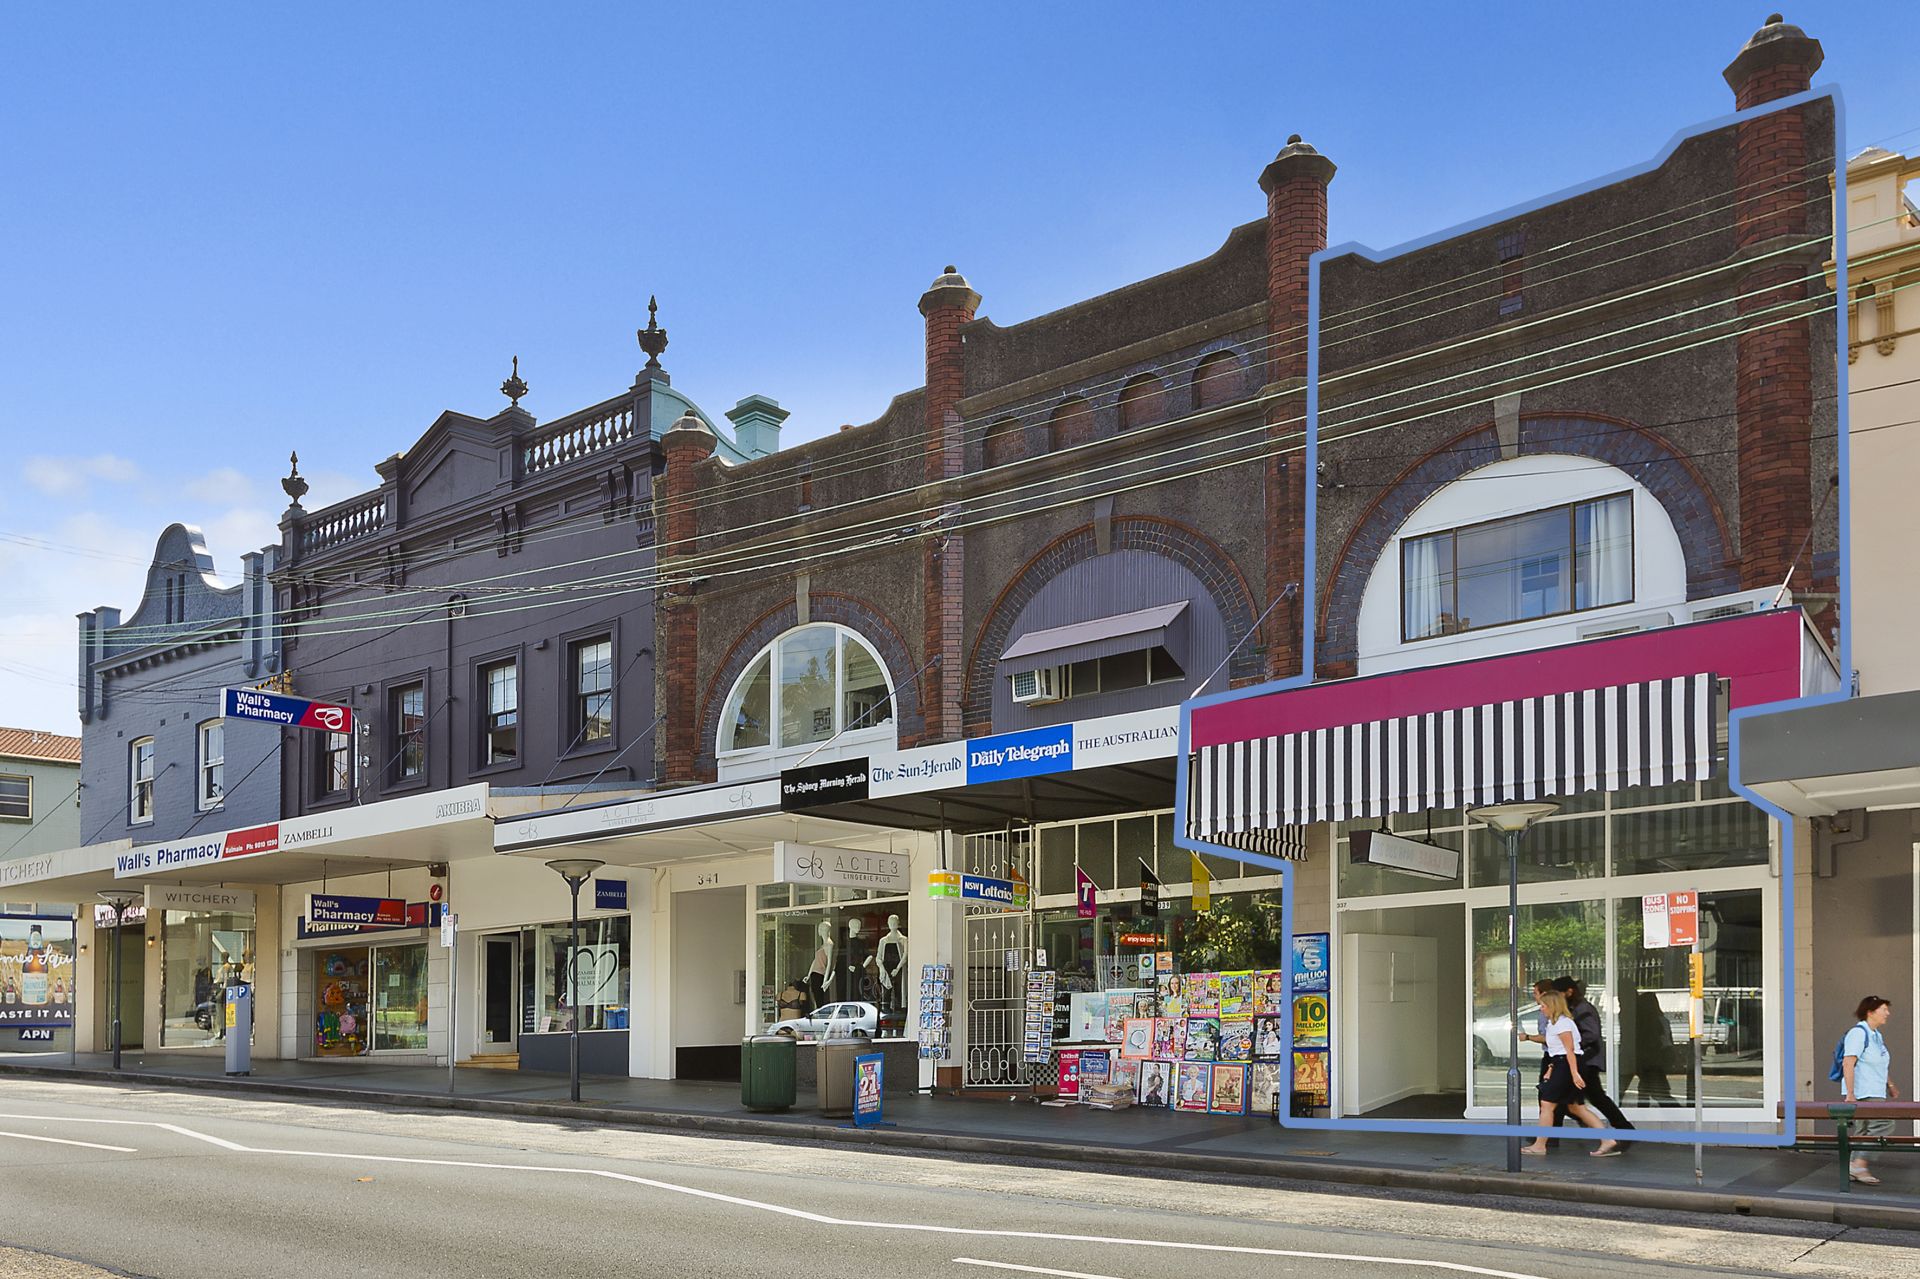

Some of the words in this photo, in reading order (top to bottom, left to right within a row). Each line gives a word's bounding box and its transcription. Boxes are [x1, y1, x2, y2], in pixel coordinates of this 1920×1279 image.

[236, 691, 271, 708] Wall's
[236, 703, 294, 723] Pharmacy
[1078, 738, 1101, 750] THE
[1102, 726, 1178, 747] AUSTRALIAN
[971, 749, 1006, 767] Daily
[1005, 739, 1070, 762] Telegraph
[873, 768, 894, 782] The
[897, 757, 962, 778] Sun-Herald
[783, 784, 796, 794] The
[796, 782, 818, 794] Sydney
[820, 777, 845, 790] Morning
[845, 773, 867, 787] Herald
[435, 799, 481, 818] AKUBRA
[284, 826, 333, 844] ZAMBELLI
[117, 853, 151, 871] Wall's
[157, 842, 222, 865] Pharmacy
[0, 859, 52, 880] ITCHERY
[843, 873, 873, 882] LINGERIE
[166, 893, 239, 905] WITCHERY
[964, 881, 980, 890] NSW
[979, 883, 1013, 900] Lotteries
[314, 899, 339, 909] Wall's
[1646, 896, 1663, 905] BUS
[1676, 895, 1689, 904] NO
[314, 909, 374, 922] Pharmacy
[1644, 904, 1665, 913] ZONE
[1669, 905, 1696, 914] STOPPING
[1294, 970, 1328, 983] MILLION
[239, 986, 246, 997] P
[0, 1010, 32, 1018] ASTE
[37, 1010, 49, 1018] IT
[54, 1010, 72, 1018] AL
[1299, 1002, 1326, 1022] 10
[22, 1030, 50, 1039] APN
[1299, 1060, 1324, 1083] 21
[860, 1073, 877, 1097] 21
[1295, 1082, 1327, 1091] MILLION
